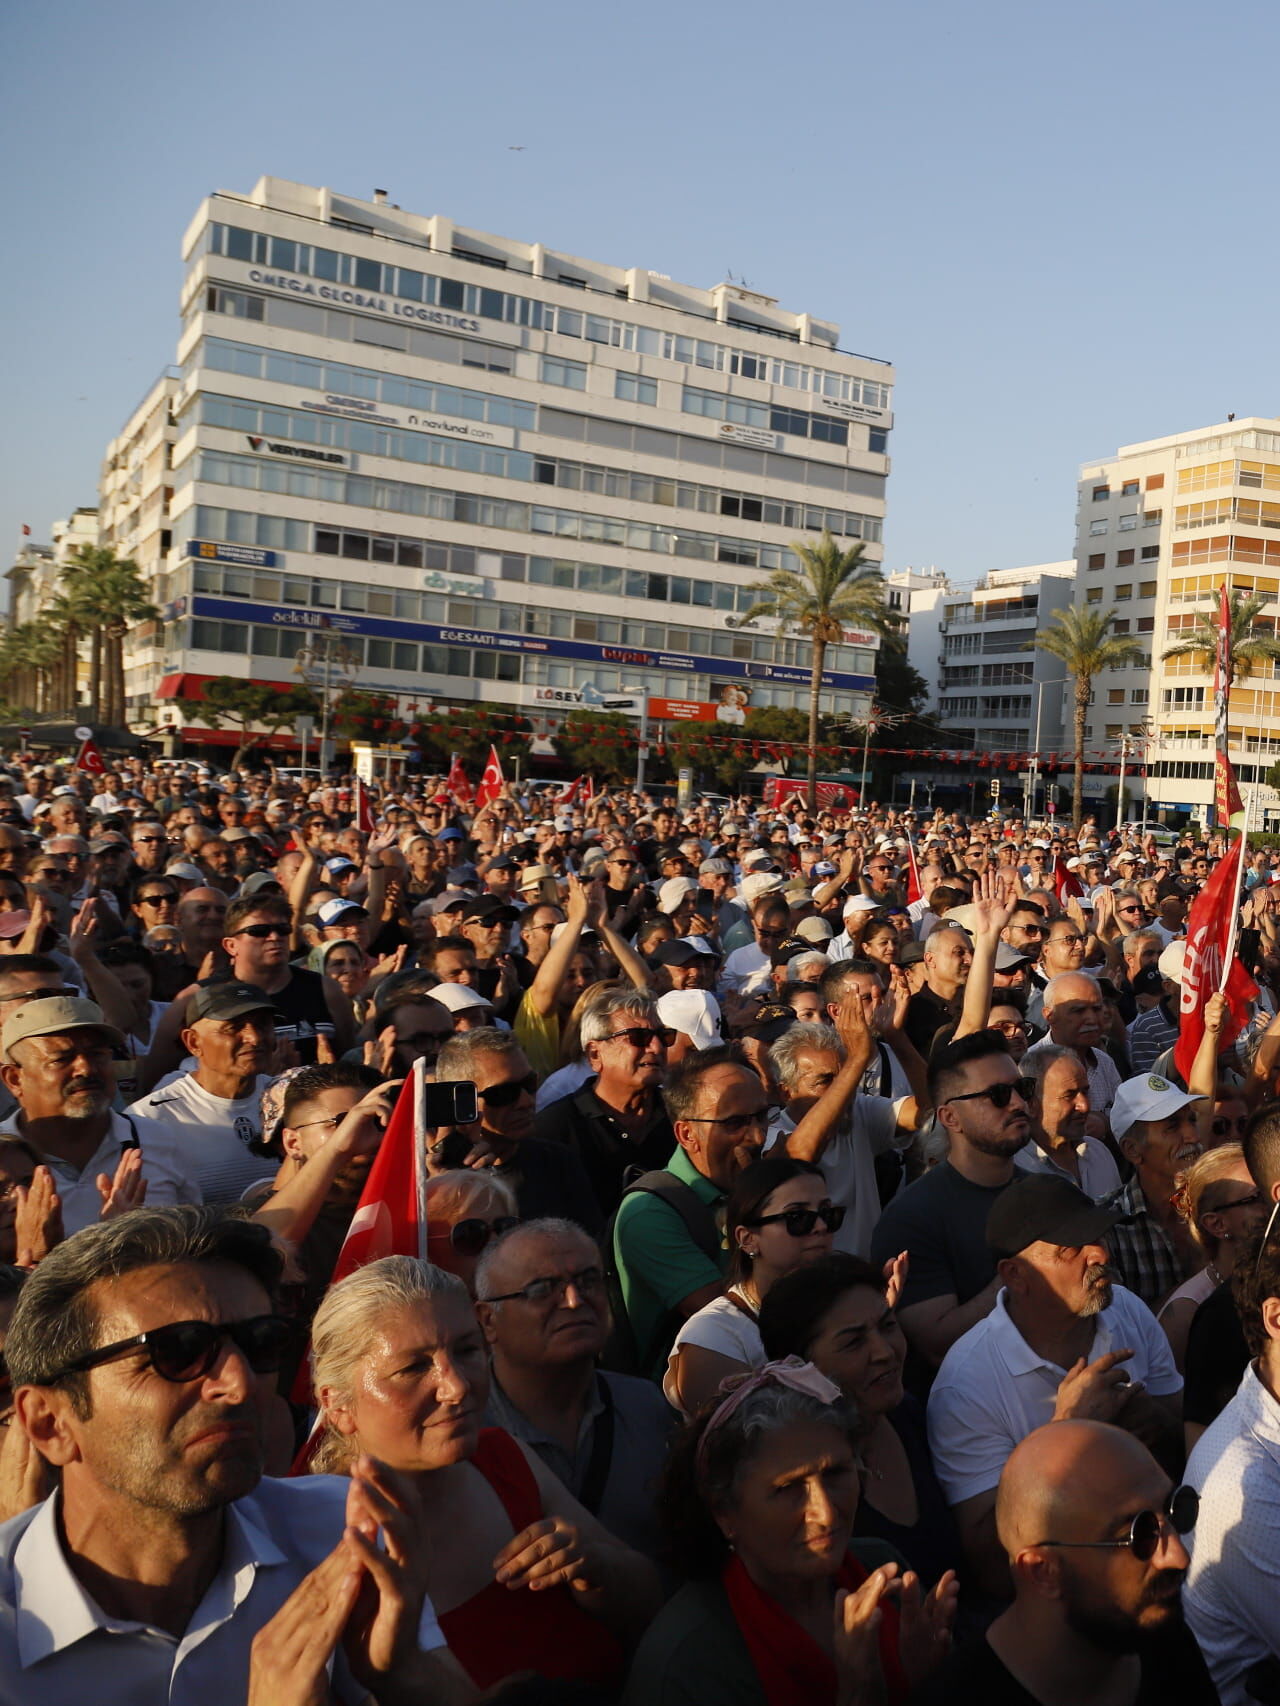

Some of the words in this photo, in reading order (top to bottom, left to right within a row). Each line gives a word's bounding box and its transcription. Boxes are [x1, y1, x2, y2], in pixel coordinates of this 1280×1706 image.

[249, 270, 316, 296] OMEGA
[319, 286, 386, 312] GLOBAL
[393, 303, 480, 332] LOGISTICS
